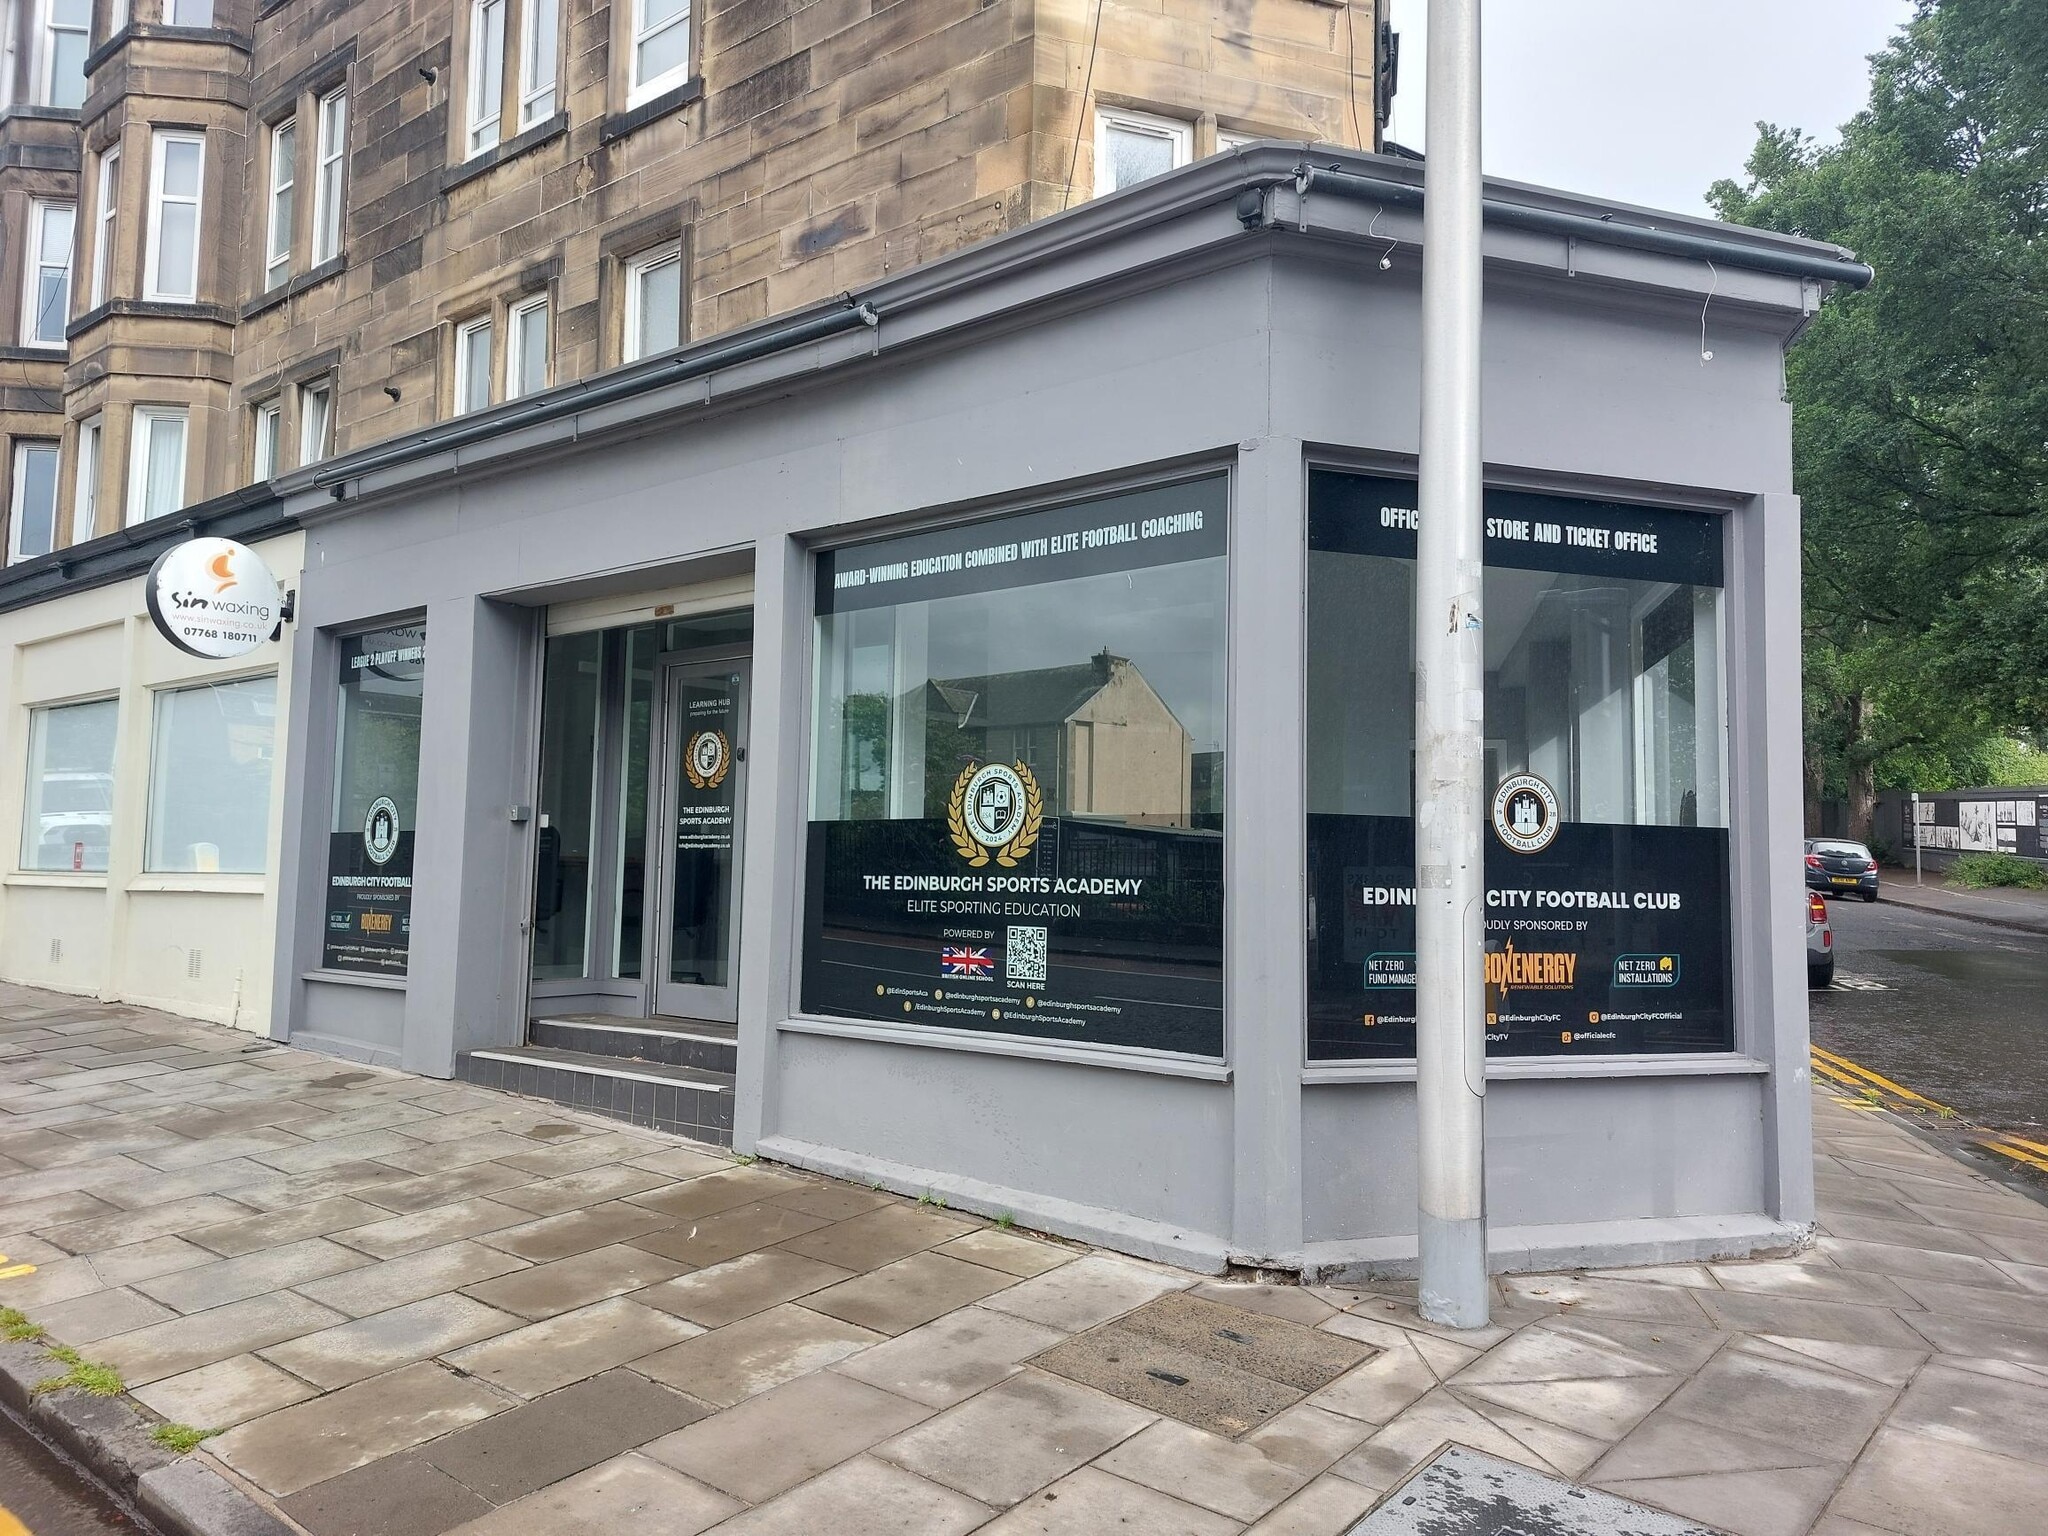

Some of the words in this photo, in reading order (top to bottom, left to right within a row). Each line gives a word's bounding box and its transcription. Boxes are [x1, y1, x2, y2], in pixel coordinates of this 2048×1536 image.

[1380, 506, 1418, 530] OFFIC
[1486, 517, 1530, 542] STORE
[1533, 523, 1561, 544] AND
[1565, 525, 1610, 549] TICKET
[1613, 530, 1658, 554] OFFICE
[834, 561, 909, 590] AWARD-WINNING
[910, 553, 963, 579] EDUCATION
[964, 543, 1018, 569] COMBINED
[1020, 537, 1048, 560] WITH
[1050, 530, 1080, 555] ELITE
[1081, 522, 1138, 550] FOOTBALL
[1141, 510, 1204, 539] COACHING
[211, 600, 270, 621] waxing
[183, 627, 218, 639] 07768
[222, 631, 258, 643] 180711
[689, 699, 717, 709] LEARNING
[718, 698, 731, 706] HUB
[993, 768, 1019, 789] SPORTS
[967, 770, 992, 817] EDINBURGH
[1498, 778, 1540, 804] EDINBURGH
[1540, 786, 1554, 805] CITY
[683, 806, 694, 814] THE
[695, 805, 730, 814] EDINBURGH
[1007, 791, 1023, 834] ACADEMY
[679, 817, 702, 825] SPORTS
[702, 816, 731, 824] ACADEMY
[969, 820, 980, 835] THE
[1499, 823, 1537, 848] FOOTBALL
[1537, 825, 1553, 844] CLUB
[332, 876, 366, 887] EDINBURGH
[366, 876, 380, 887] CITY
[380, 877, 412, 887] FOOTBALL
[863, 875, 890, 891] THE
[894, 875, 983, 893] EDINBURGH
[986, 877, 1050, 894] SPORTS
[1053, 878, 1143, 896] ACADEMY
[1363, 887, 1416, 906] EDIN
[1486, 889, 1532, 908] CITY
[1536, 890, 1630, 909] FOOTBALL
[1633, 892, 1681, 910] CLUB
[907, 900, 937, 913] ELITE
[939, 901, 1001, 916] SPORTING
[1004, 902, 1081, 918] EDUCATION
[1513, 920, 1573, 931] SPONSORED
[1575, 921, 1588, 931] BY
[943, 928, 983, 939] POWERED
[984, 930, 995, 939] BY
[1368, 960, 1383, 971] NET
[1385, 960, 1404, 971] ZERO
[1618, 960, 1634, 971] NET
[1635, 961, 1656, 971] ZERO
[1368, 974, 1388, 984] FUND
[1389, 974, 1416, 984] MANAGE
[1618, 973, 1673, 983] INSTALLATIONS
[1006, 981, 1025, 989] SCAN
[1026, 982, 1046, 990] HERE
[1037, 999, 1122, 1014] @edinburghsportsacademy
[1377, 1015, 1416, 1025] @Edinburg
[1498, 1014, 1561, 1022] @EdinburghCityFC
[1600, 1012, 1682, 1021] @EdinburghCityFCOfficial
[1484, 1033, 1508, 1041] CityTV
[1573, 1032, 1616, 1041] @officialecfc
